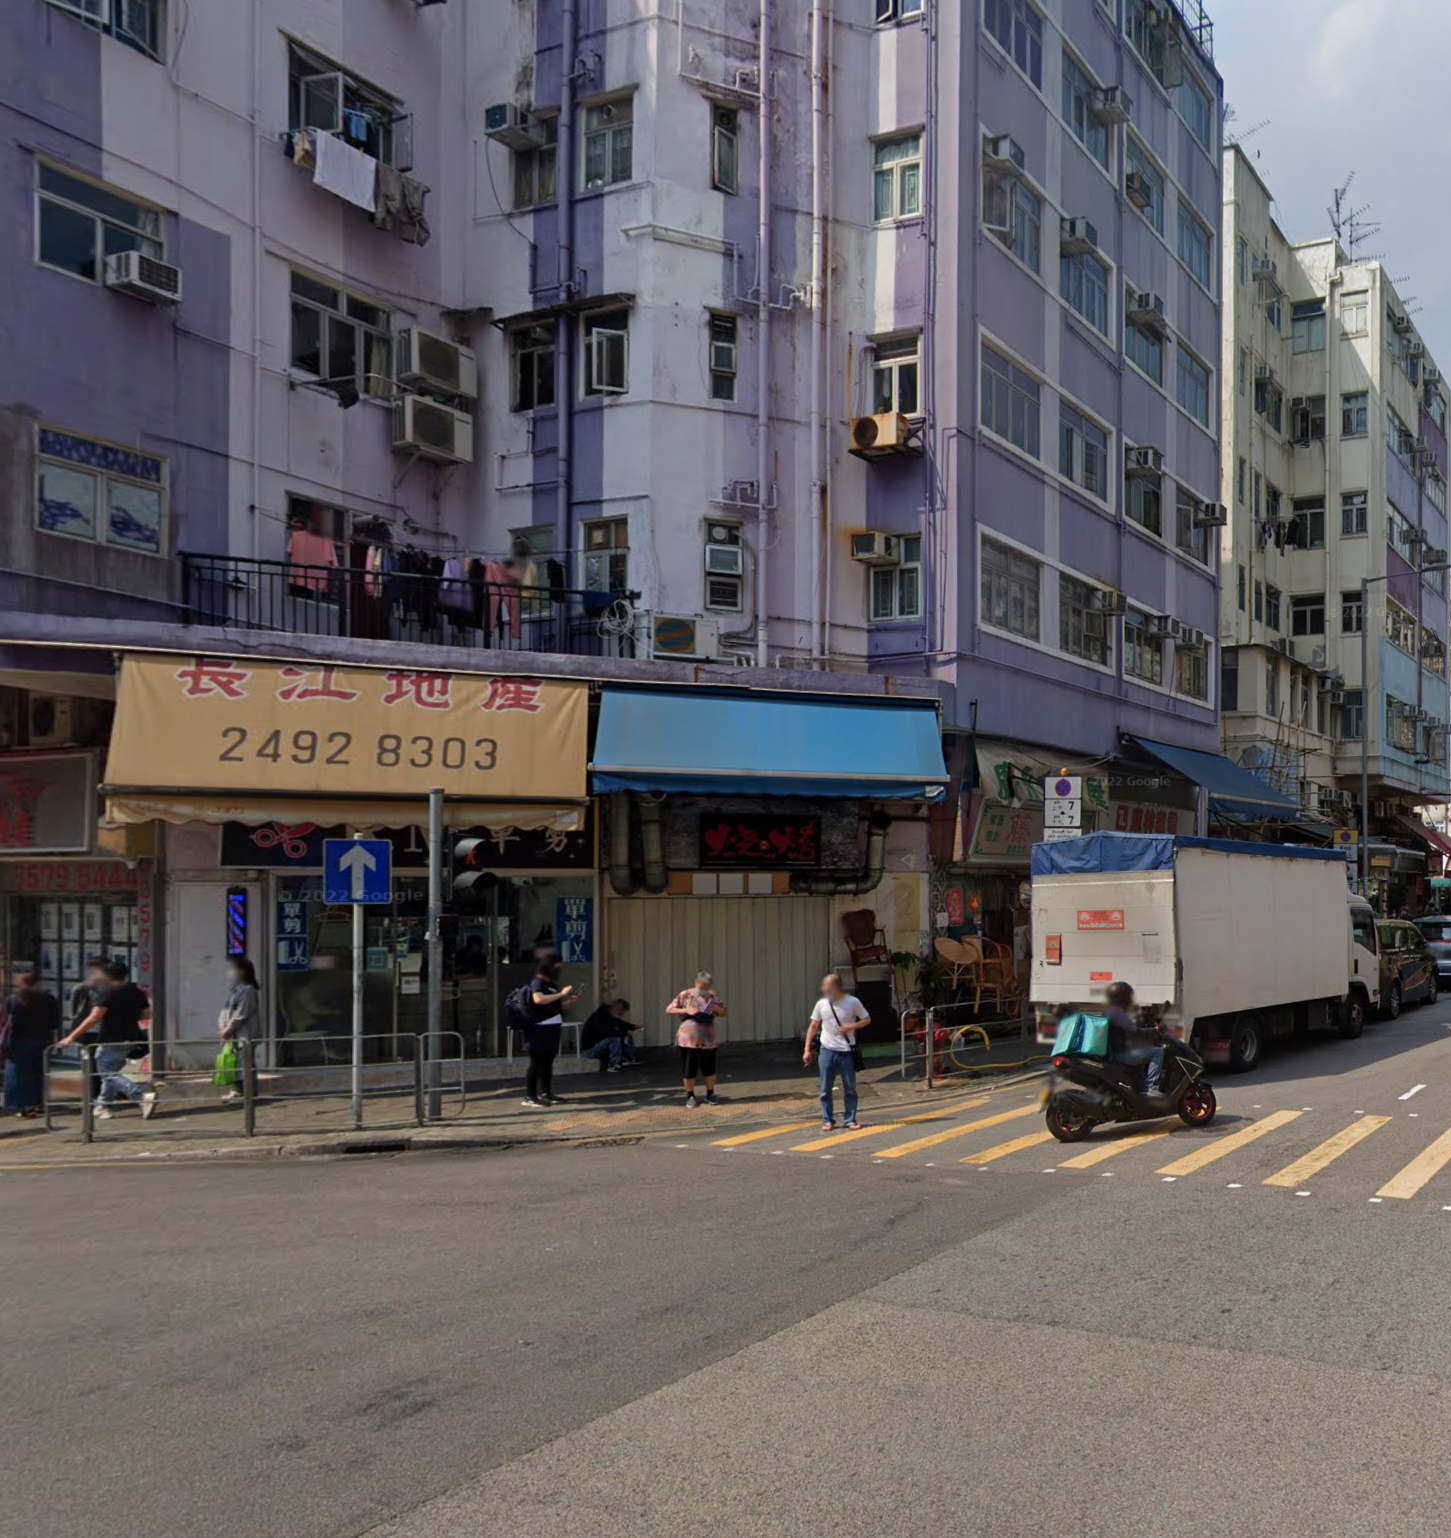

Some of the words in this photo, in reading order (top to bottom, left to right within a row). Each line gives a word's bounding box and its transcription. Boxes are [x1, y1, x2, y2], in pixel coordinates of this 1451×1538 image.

[176, 657, 544, 713] 長江地產
[218, 726, 352, 766] 2492
[376, 733, 498, 770] 8303
[1067, 815, 1074, 825] 7
[1068, 801, 1075, 811] 7
[563, 898, 588, 941] 單剪
